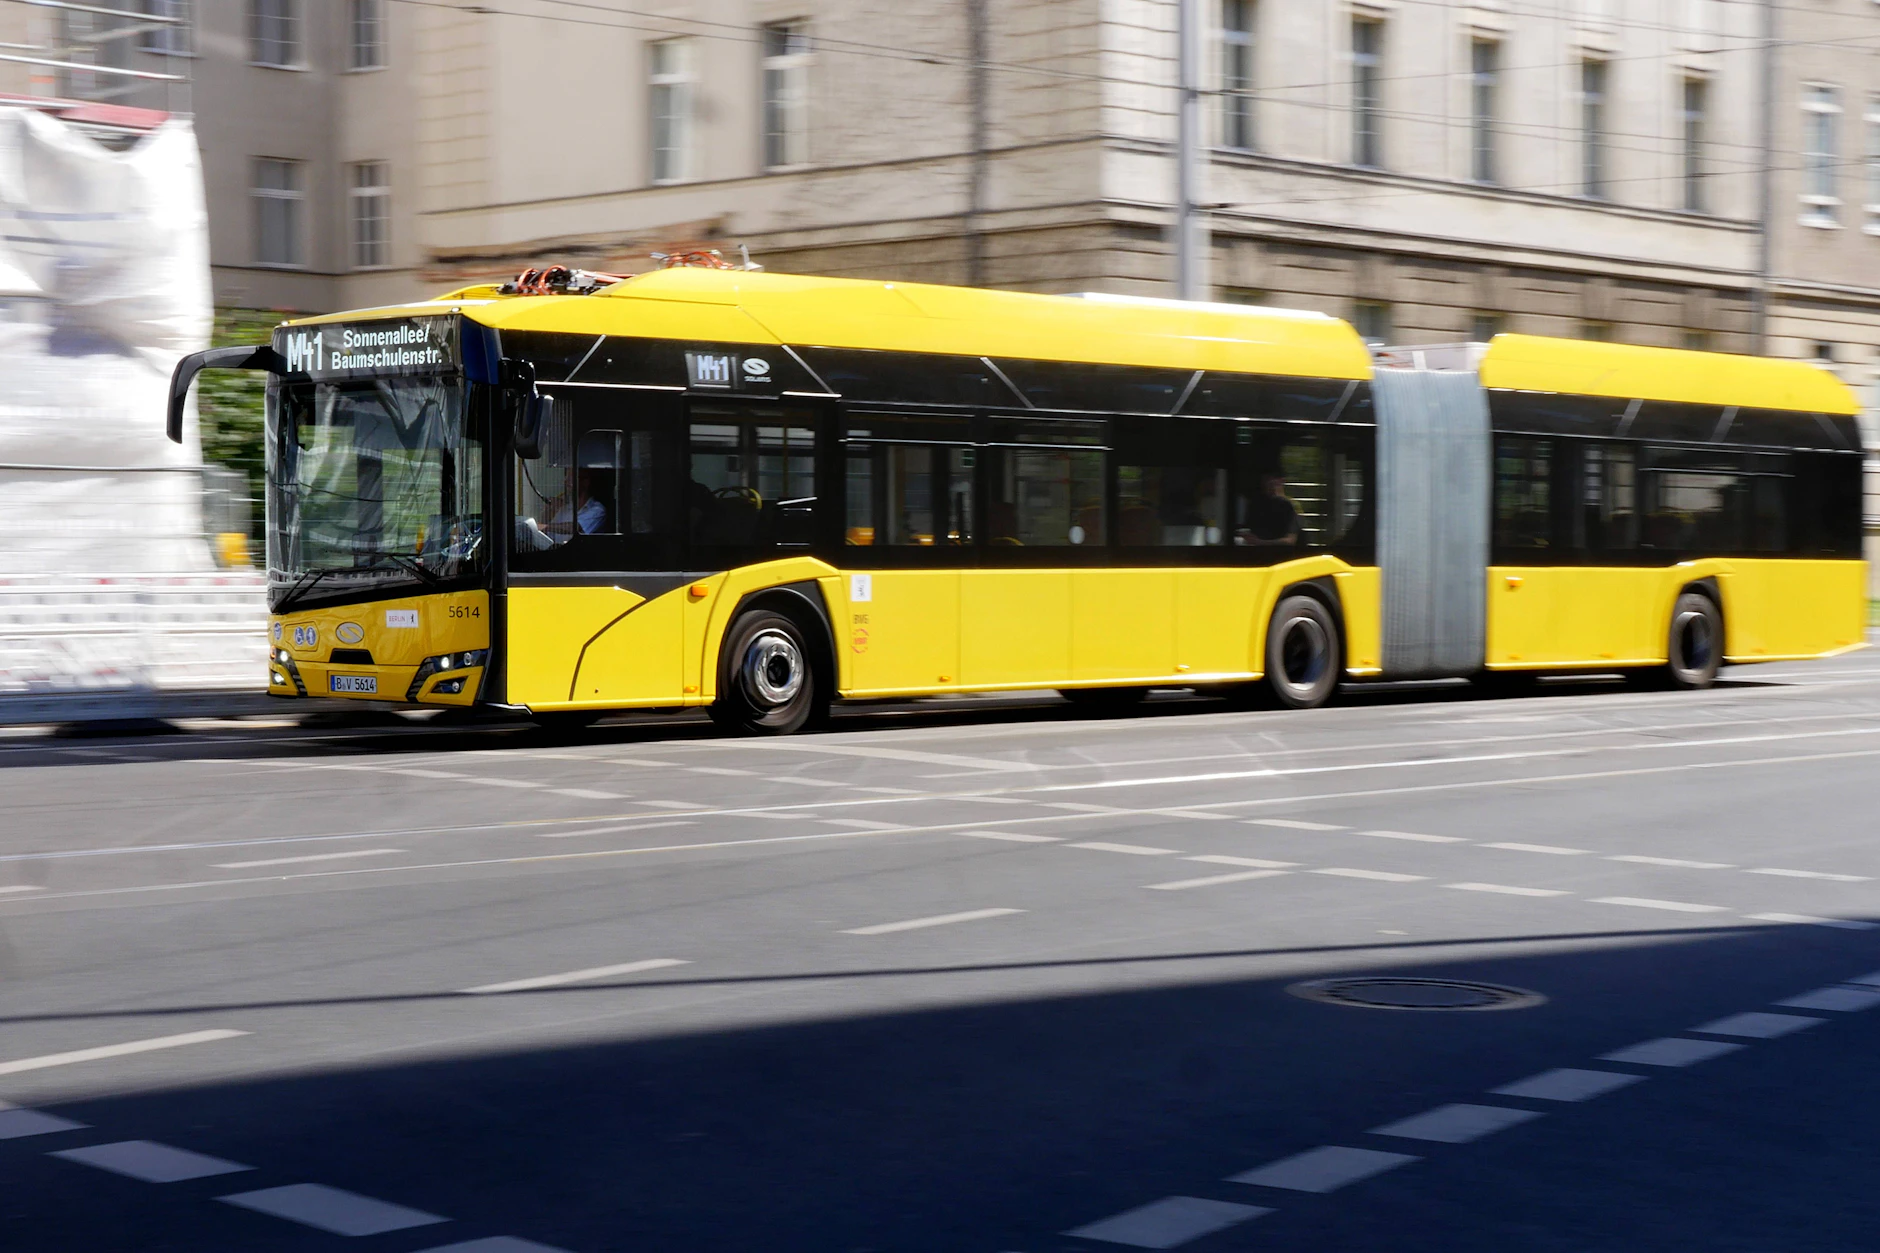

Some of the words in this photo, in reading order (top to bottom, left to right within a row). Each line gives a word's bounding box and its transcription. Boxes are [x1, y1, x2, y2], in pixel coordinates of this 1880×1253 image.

[343, 324, 430, 348] Sonnenallee/
[287, 332, 323, 372] M41
[331, 347, 442, 370] Baumschulenstr.
[696, 355, 729, 381] M41
[448, 606, 480, 618] 5614
[336, 677, 342, 690] B
[346, 678, 351, 690] V
[354, 678, 375, 691] 5614
